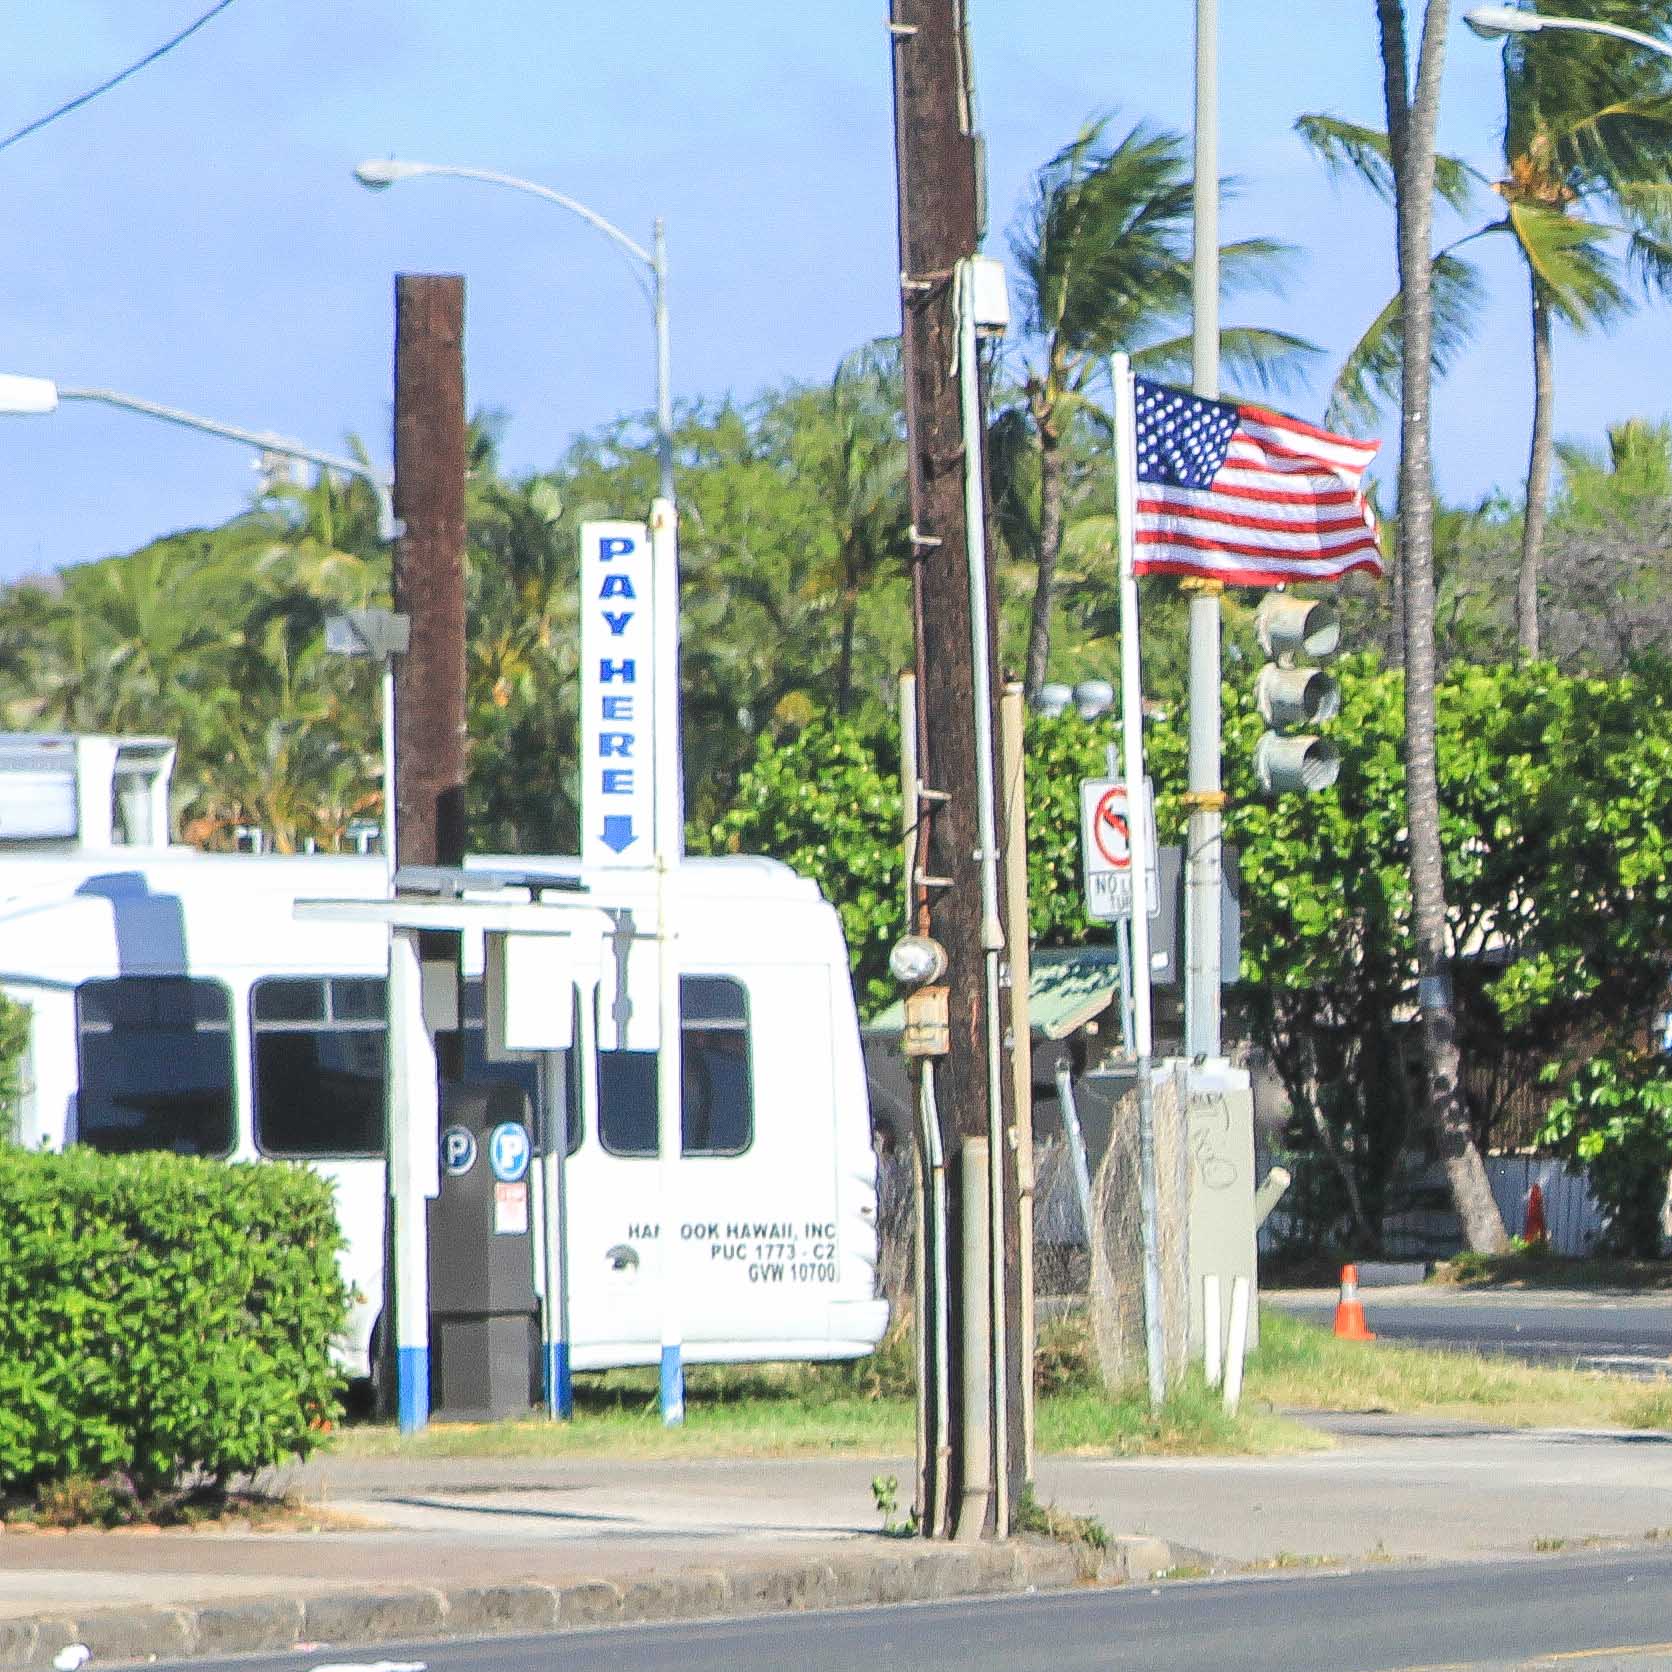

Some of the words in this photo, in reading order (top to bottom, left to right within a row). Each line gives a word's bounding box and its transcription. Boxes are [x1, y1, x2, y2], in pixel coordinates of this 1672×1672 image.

[599, 537, 635, 636] PAY
[599, 658, 636, 795] HERE
[448, 1134, 469, 1165] P
[501, 1134, 527, 1168] P
[805, 1223, 836, 1239] INC
[711, 1243, 748, 1261] PUC
[813, 1244, 836, 1260] C2
